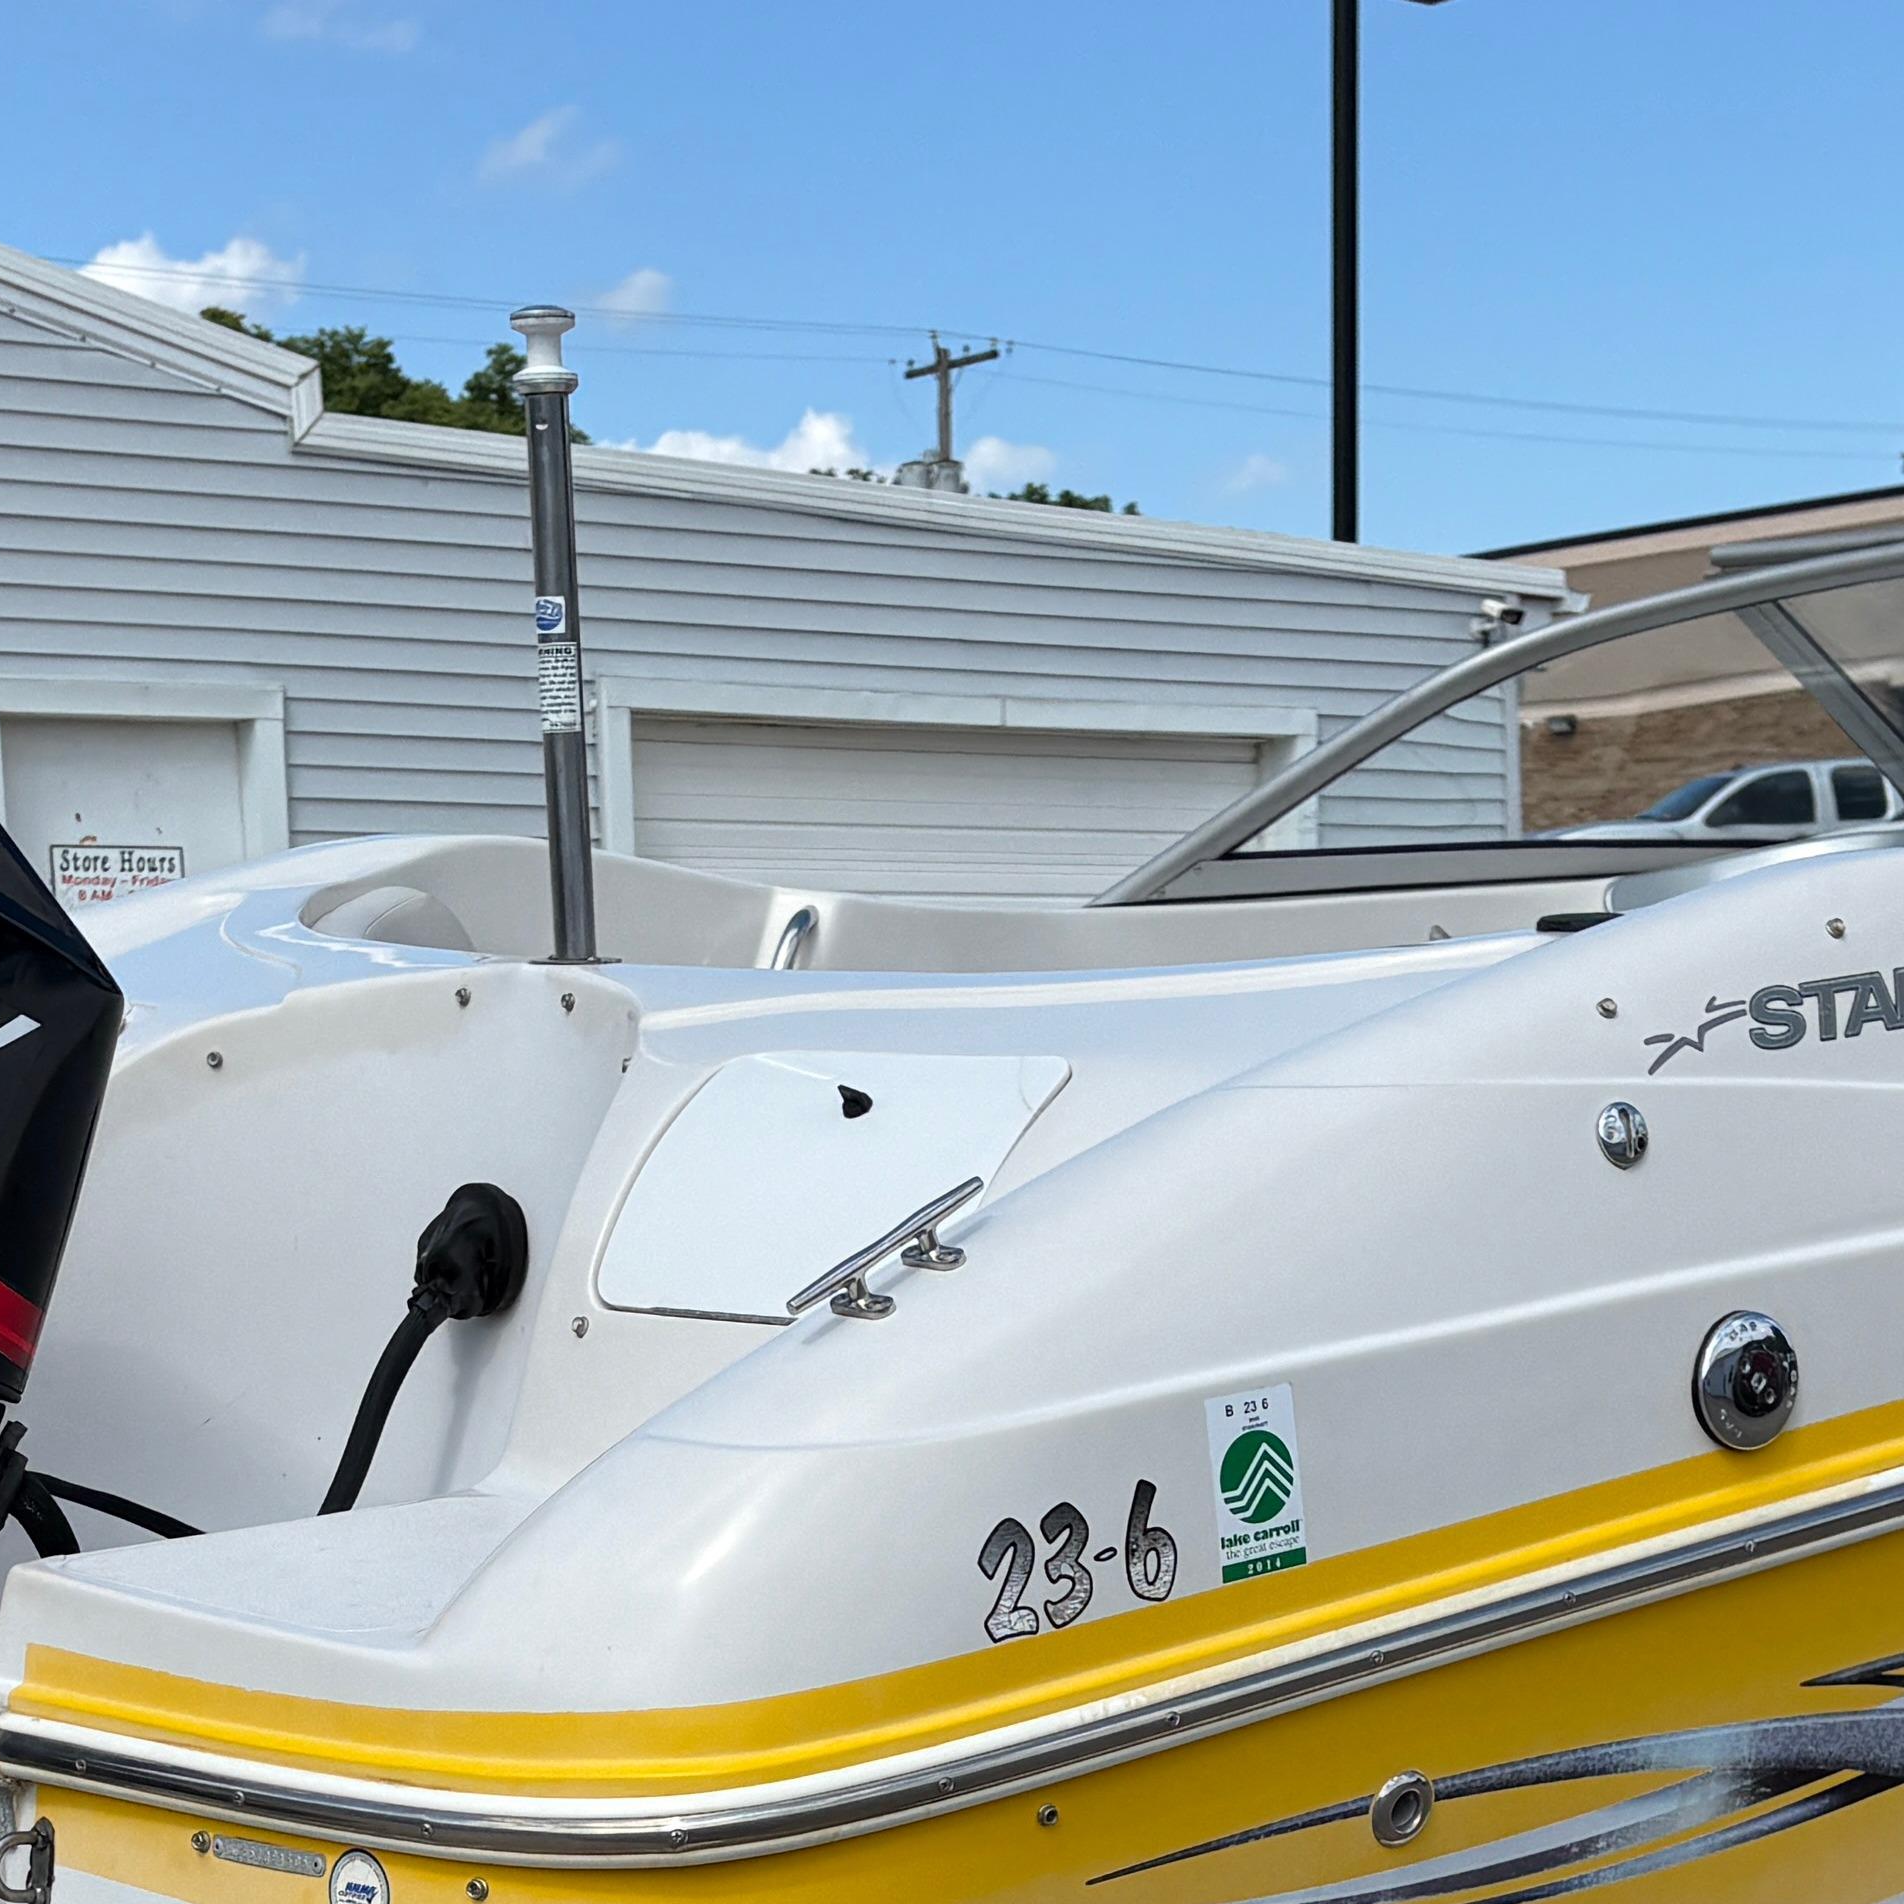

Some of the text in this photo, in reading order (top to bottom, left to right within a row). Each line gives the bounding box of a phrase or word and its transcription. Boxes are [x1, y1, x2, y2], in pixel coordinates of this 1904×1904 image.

[59, 849, 176, 874] Store Hours
[62, 874, 117, 888] Monday
[1224, 1397, 1269, 1418] B 23 6
[1220, 1519, 1301, 1550] lake carroll
[1226, 1535, 1301, 1560] the great escape
[977, 1478, 1179, 1644] 23-6
[1247, 1557, 1281, 1575] 2014
